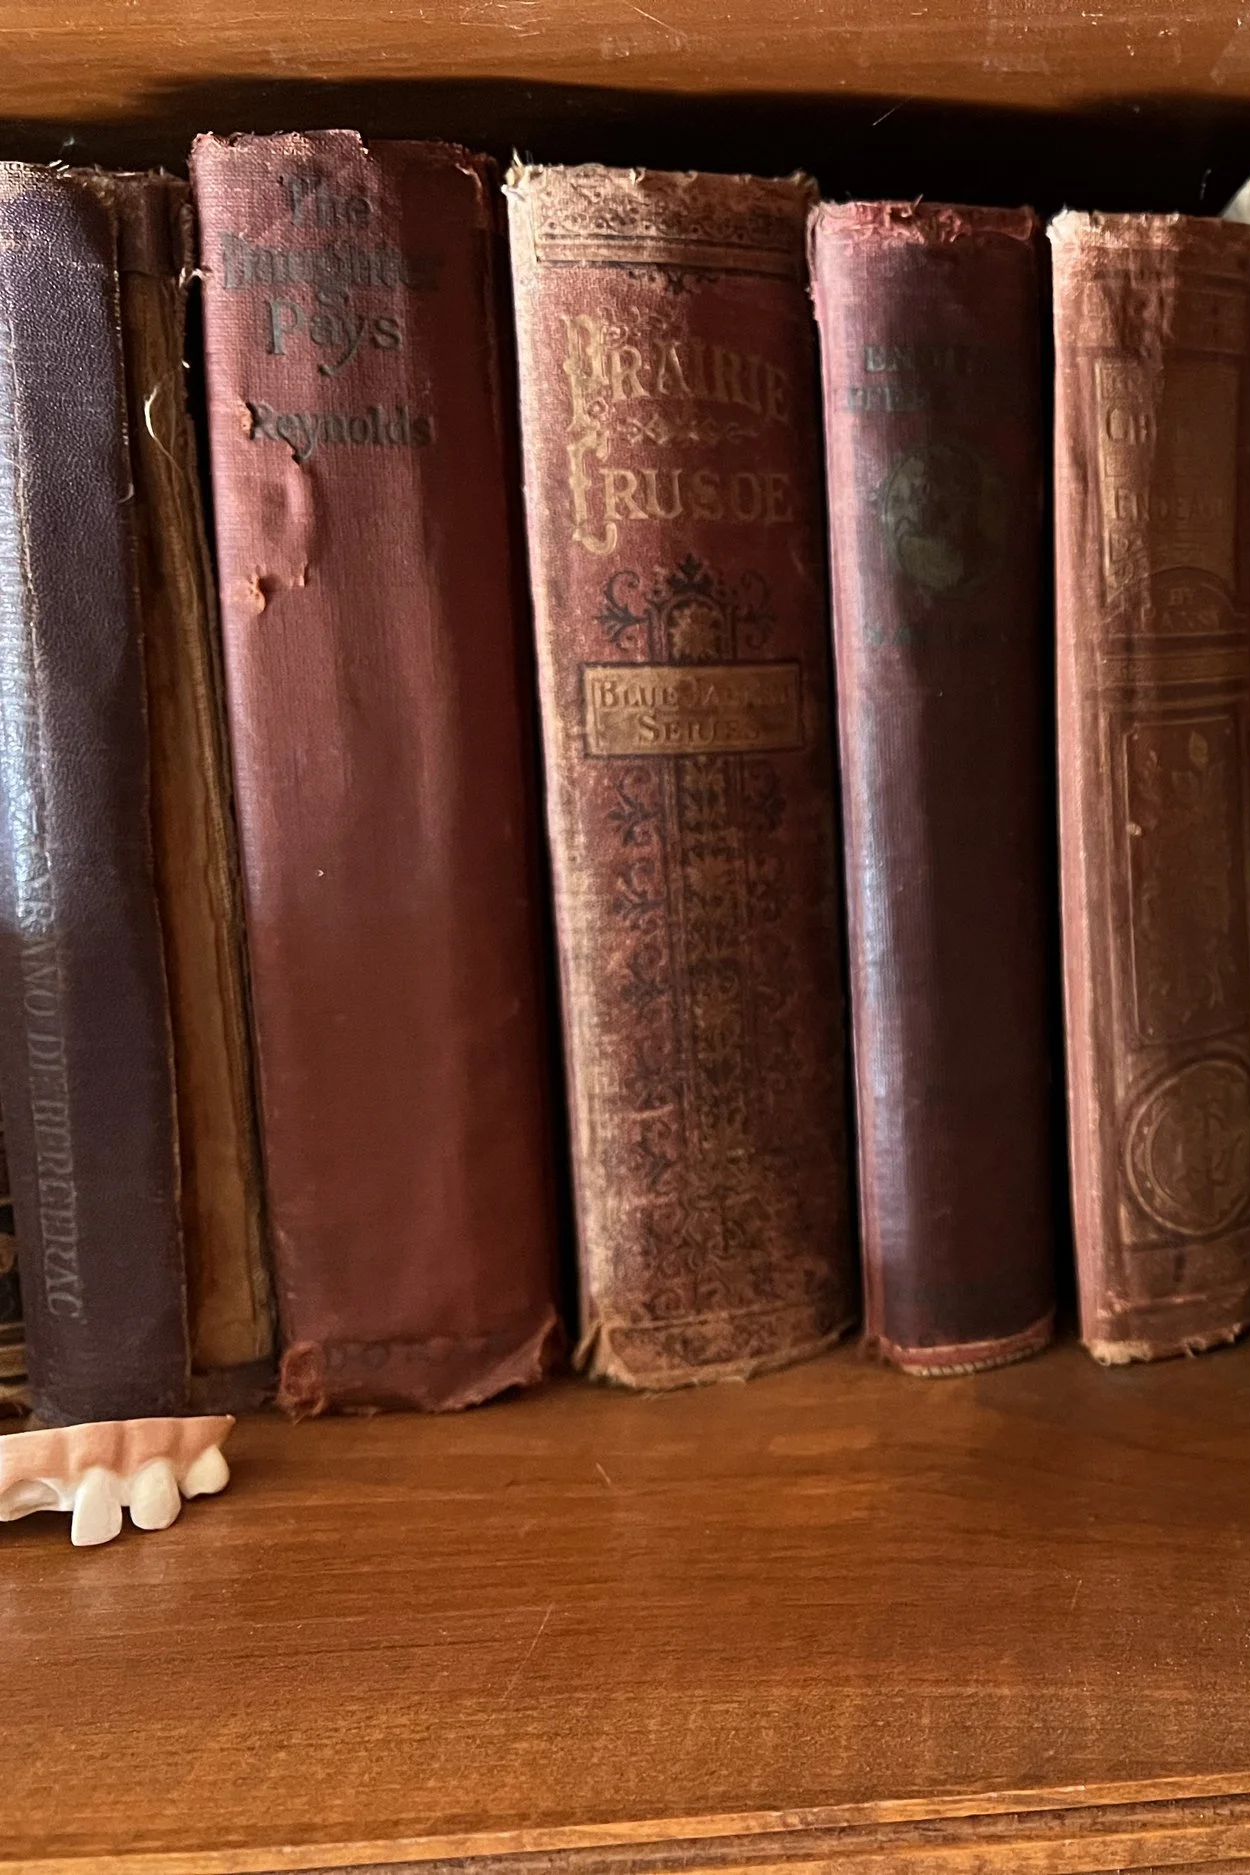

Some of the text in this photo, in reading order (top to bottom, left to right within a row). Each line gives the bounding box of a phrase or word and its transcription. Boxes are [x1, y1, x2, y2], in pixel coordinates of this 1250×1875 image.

[279, 170, 373, 227] The
[266, 298, 403, 378] Pays
[246, 400, 439, 462] Reynolds
[565, 425, 794, 556] CRUSOE
